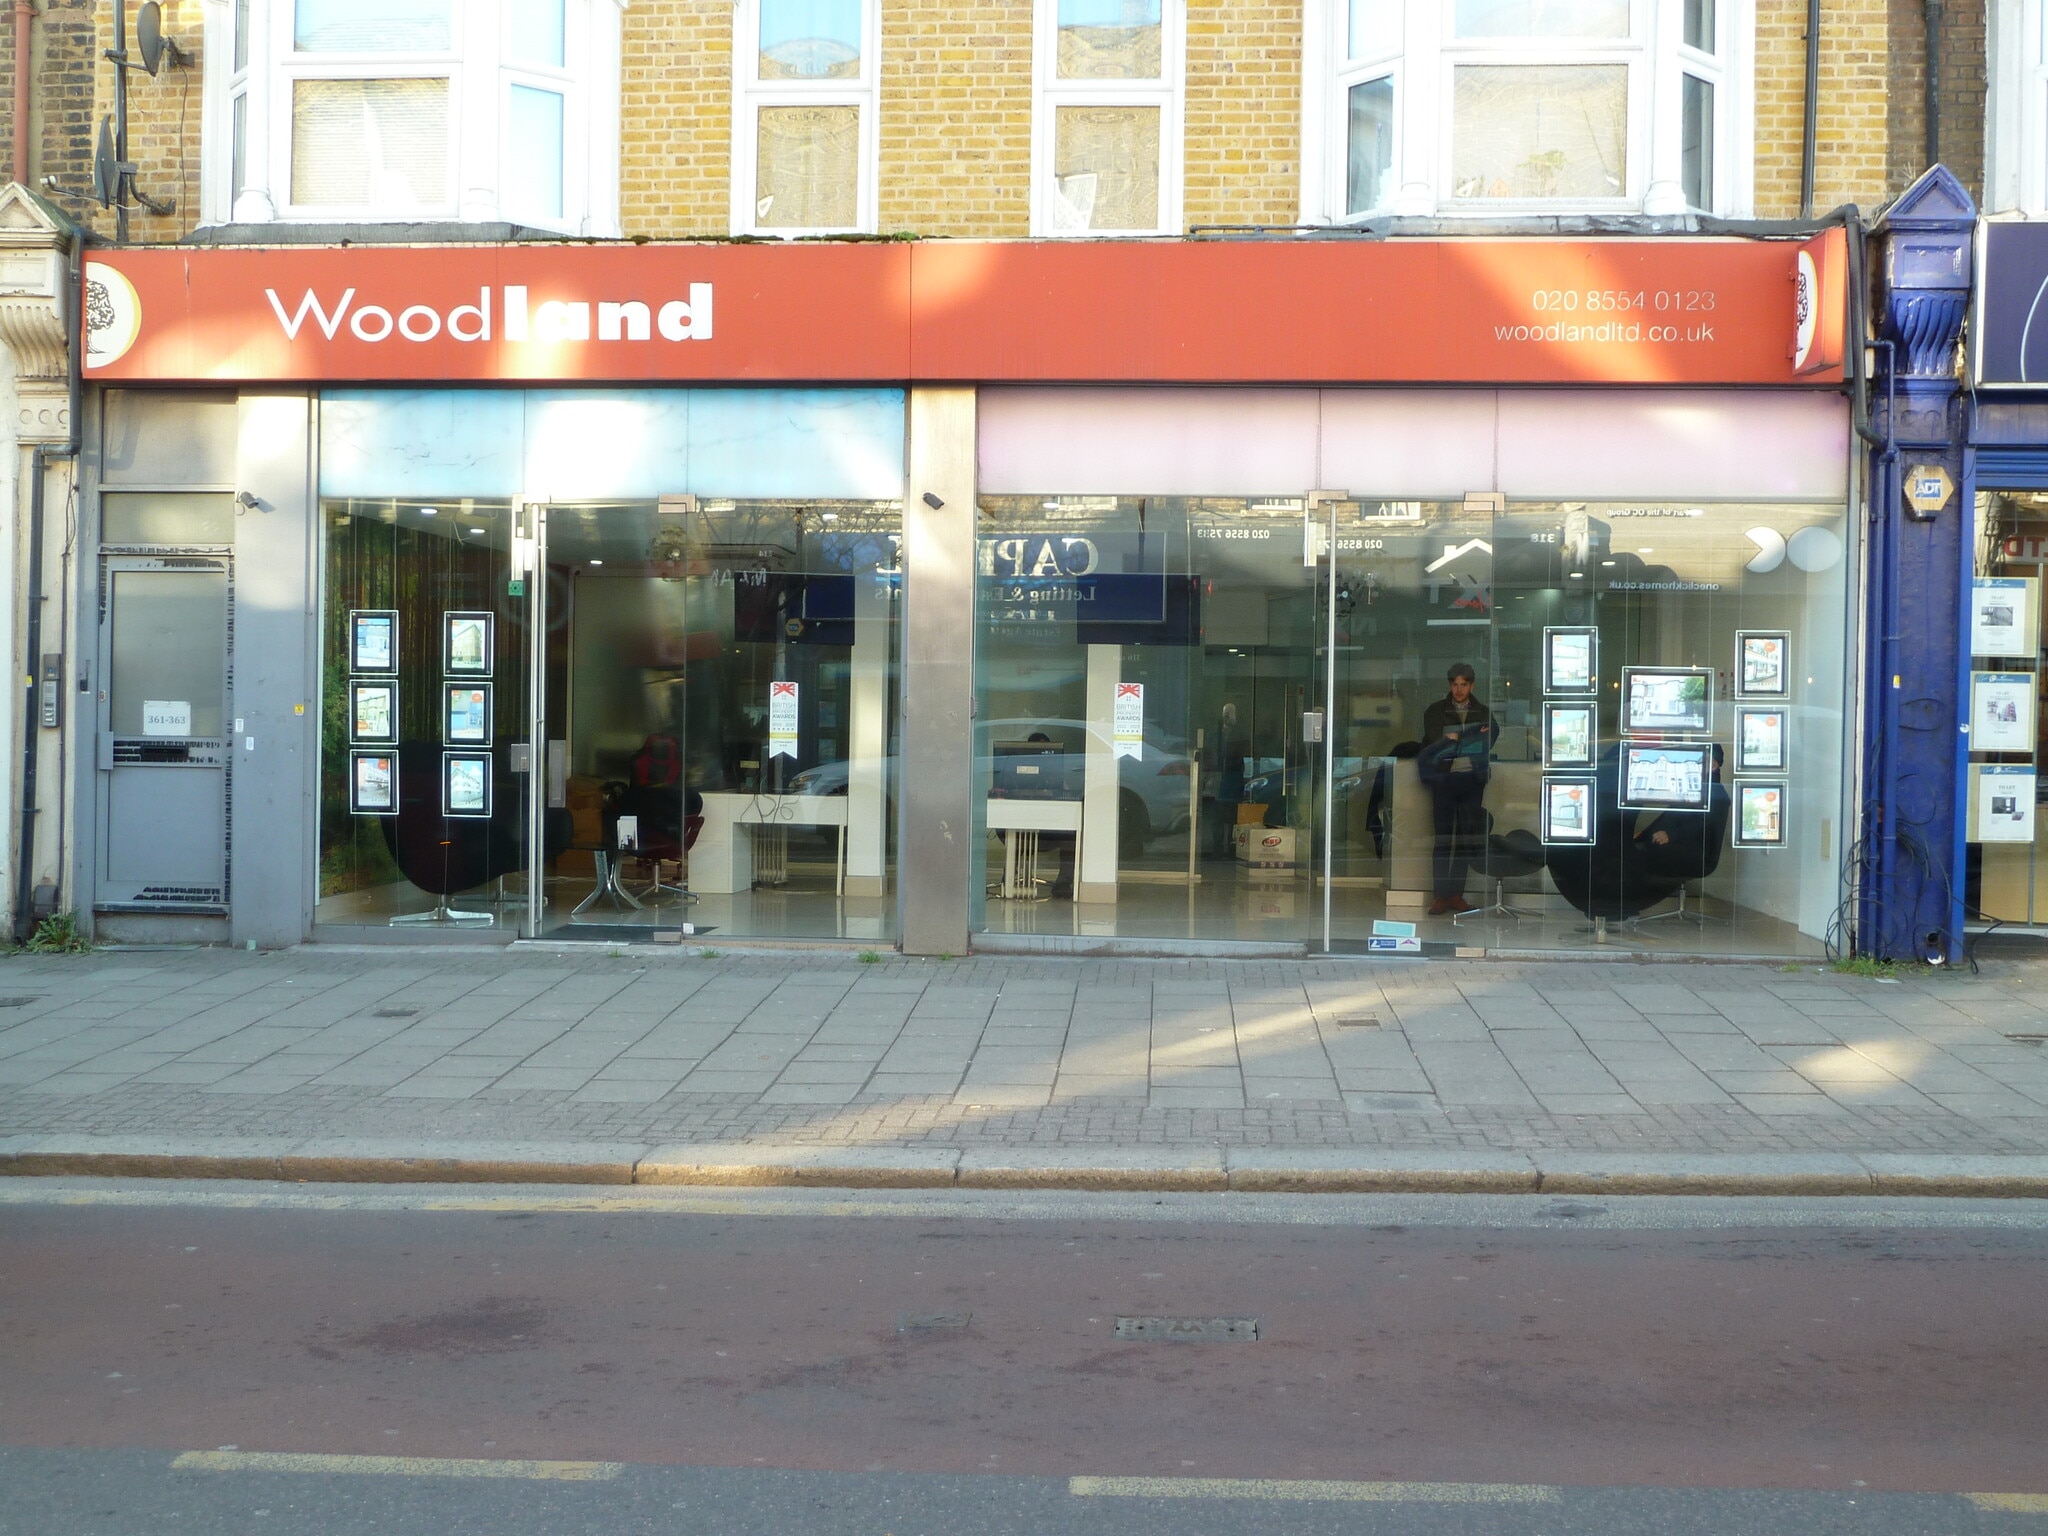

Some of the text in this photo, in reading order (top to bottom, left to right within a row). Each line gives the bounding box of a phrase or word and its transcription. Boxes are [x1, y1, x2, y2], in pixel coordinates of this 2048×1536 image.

[1532, 290, 1716, 311] 020 8554 0123
[265, 281, 713, 342] Woodland
[1494, 321, 1715, 342] woodlandltd.co.uk
[1915, 482, 1941, 495] ADT
[148, 715, 186, 724] 361-363
